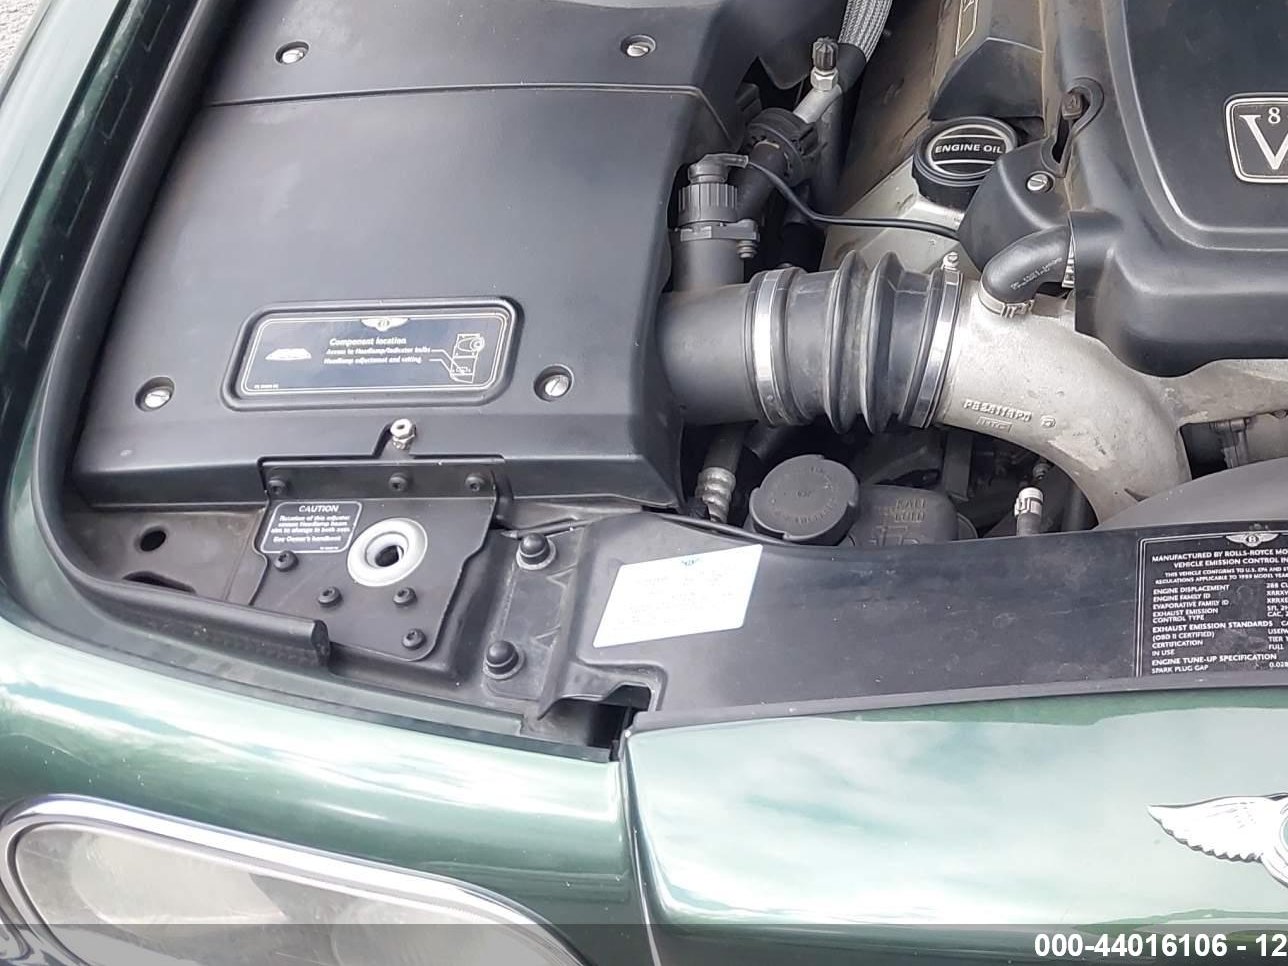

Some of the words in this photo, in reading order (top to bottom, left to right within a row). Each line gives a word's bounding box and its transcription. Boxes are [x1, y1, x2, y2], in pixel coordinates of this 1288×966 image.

[1268, 107, 1281, 124] 8
[935, 143, 980, 154] ENGINE
[983, 144, 1003, 154] OIL
[1152, 552, 1211, 562] MANUFACTURED
[1225, 549, 1273, 557] ROLLS-ROYCE
[1205, 558, 1241, 566] EMISSION
[1202, 568, 1235, 576] CONFORMS
[1180, 584, 1230, 593] DISPLACEMENT
[1153, 601, 1197, 610] EVAPORATIVE
[1152, 609, 1184, 617] EXHAUST
[1152, 625, 1187, 633] EXHAUST
[1178, 631, 1215, 639] CERTIFIED)
[1152, 640, 1203, 649] CERTIFICATION
[1152, 658, 1180, 666] ENGINE
[1182, 656, 1217, 664] TUNE-UP
[1219, 653, 1277, 662] SPECIFICATION
